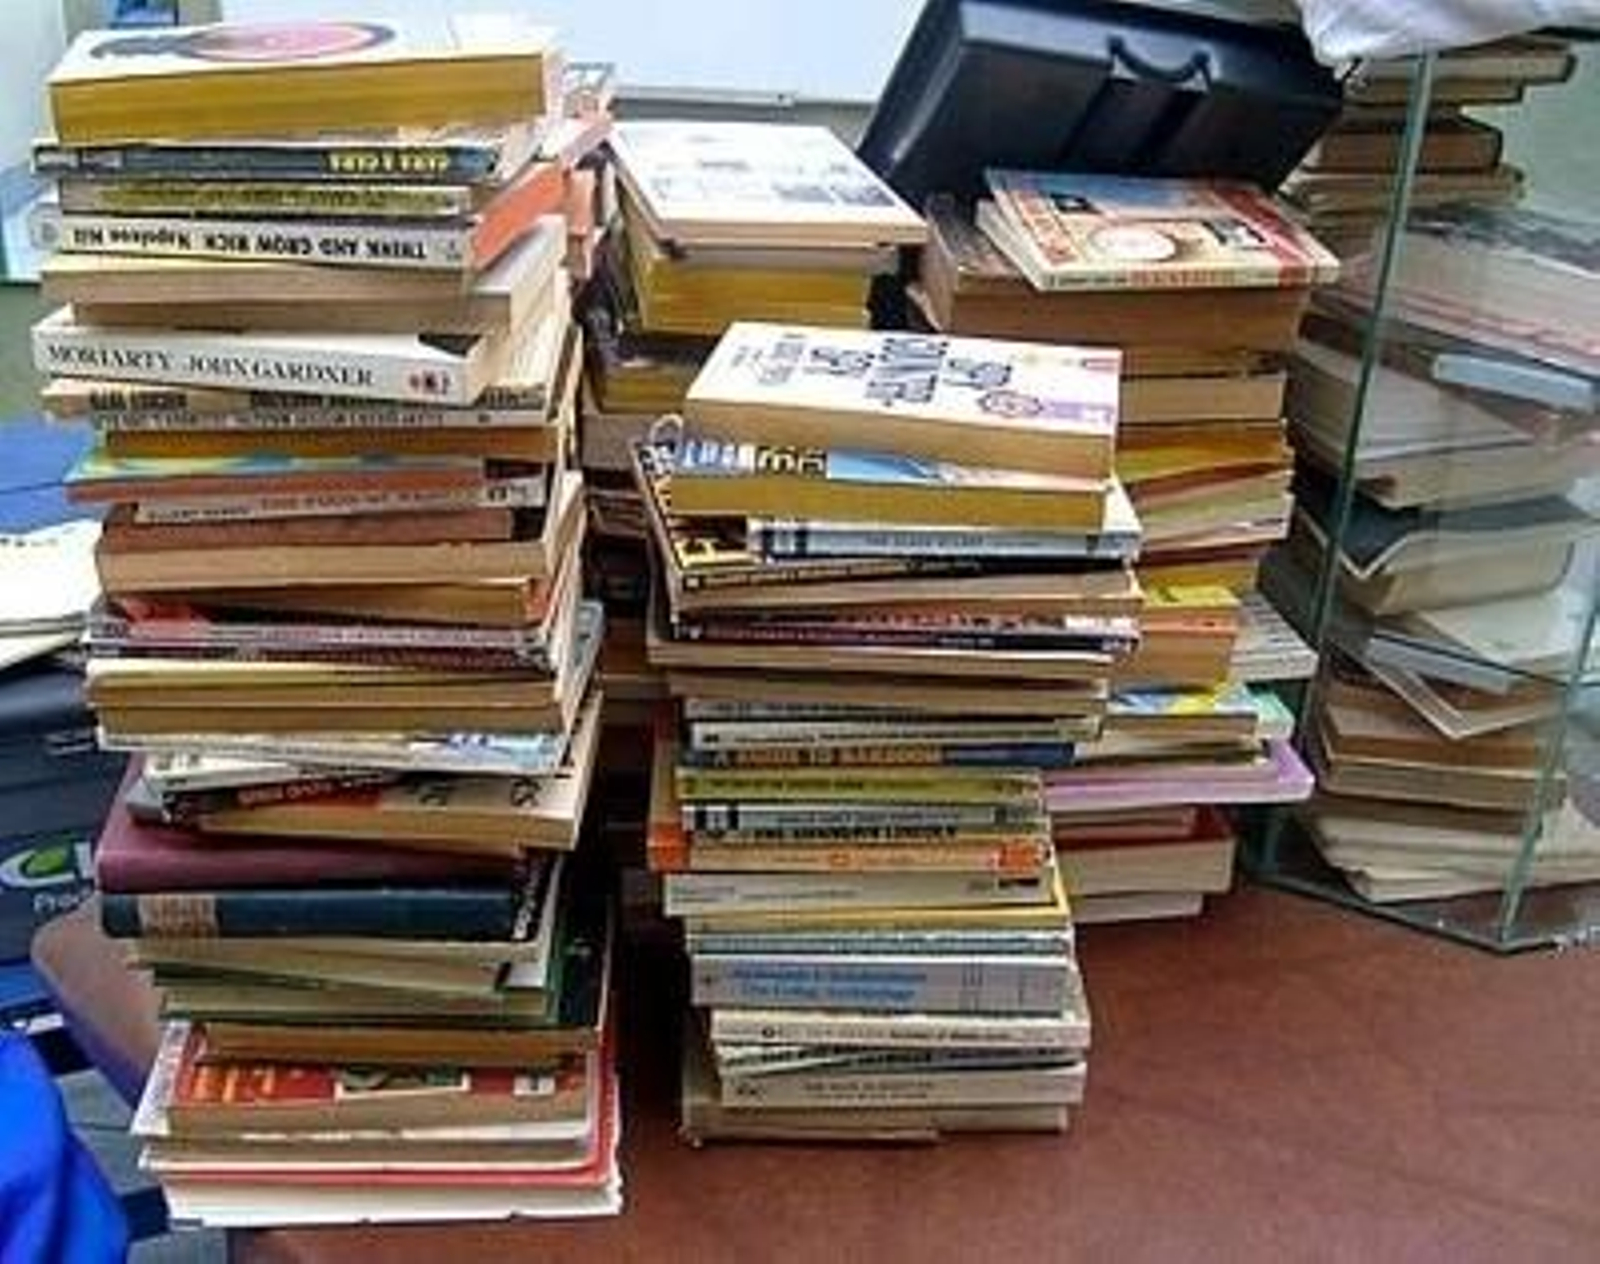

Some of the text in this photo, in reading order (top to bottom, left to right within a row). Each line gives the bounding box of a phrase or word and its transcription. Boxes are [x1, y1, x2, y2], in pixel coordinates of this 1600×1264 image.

[73, 227, 427, 259] THINK AND GROW RICH Napoleon Hill
[49, 344, 373, 387] MORIARTY JOHN GARDNER
